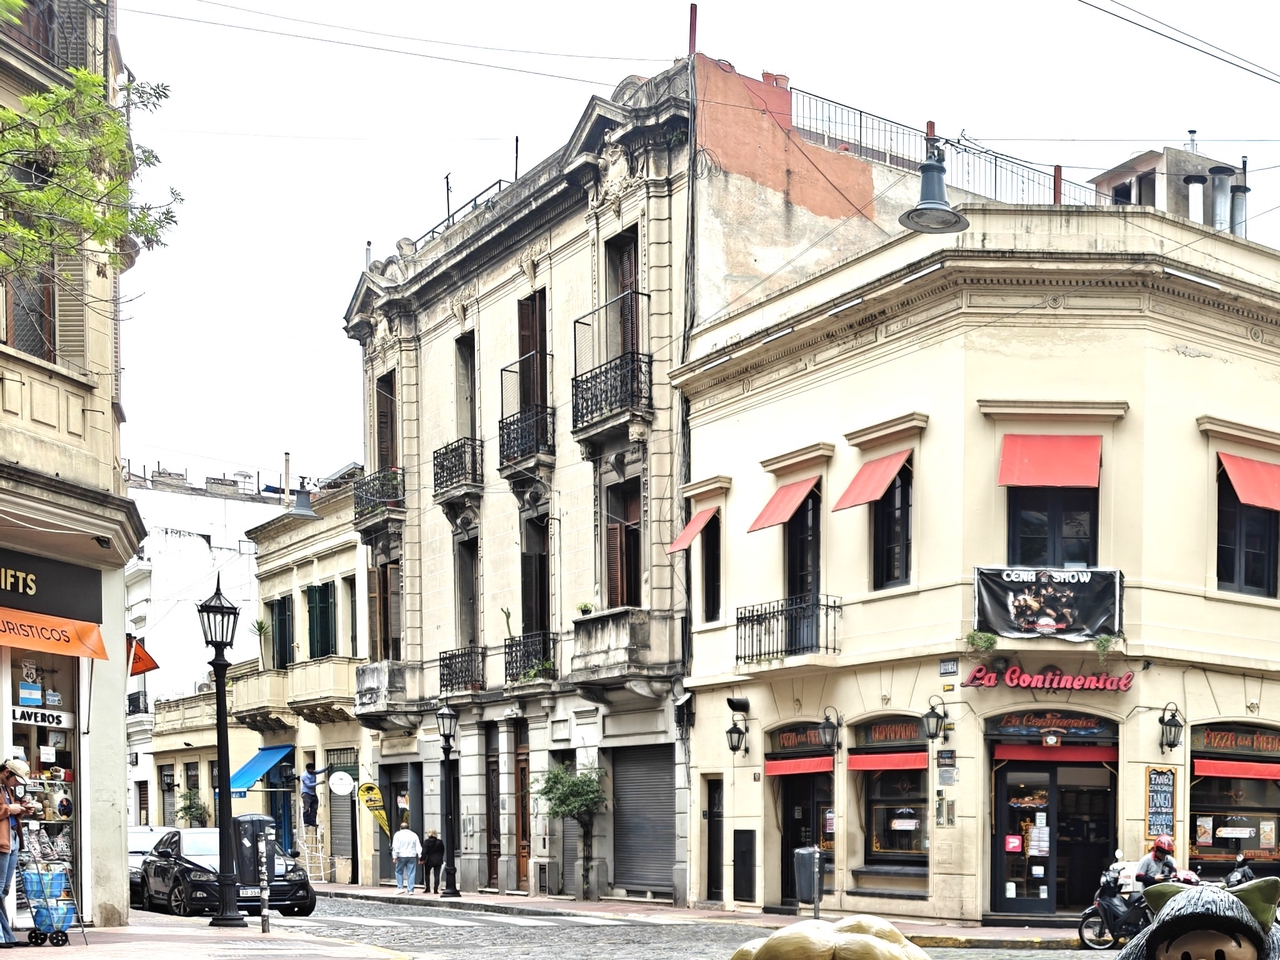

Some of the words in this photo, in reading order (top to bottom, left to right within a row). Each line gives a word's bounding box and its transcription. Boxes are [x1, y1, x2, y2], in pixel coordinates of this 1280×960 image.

[1002, 570, 1037, 582] CENA
[1052, 571, 1092, 584] SHOW
[25, 671, 34, 680] 40
[960, 664, 998, 688] La
[1004, 665, 1135, 693] Continental
[1000, 713, 1021, 728] La
[1022, 713, 1100, 729] Continental
[1203, 728, 1237, 749] PIZZA
